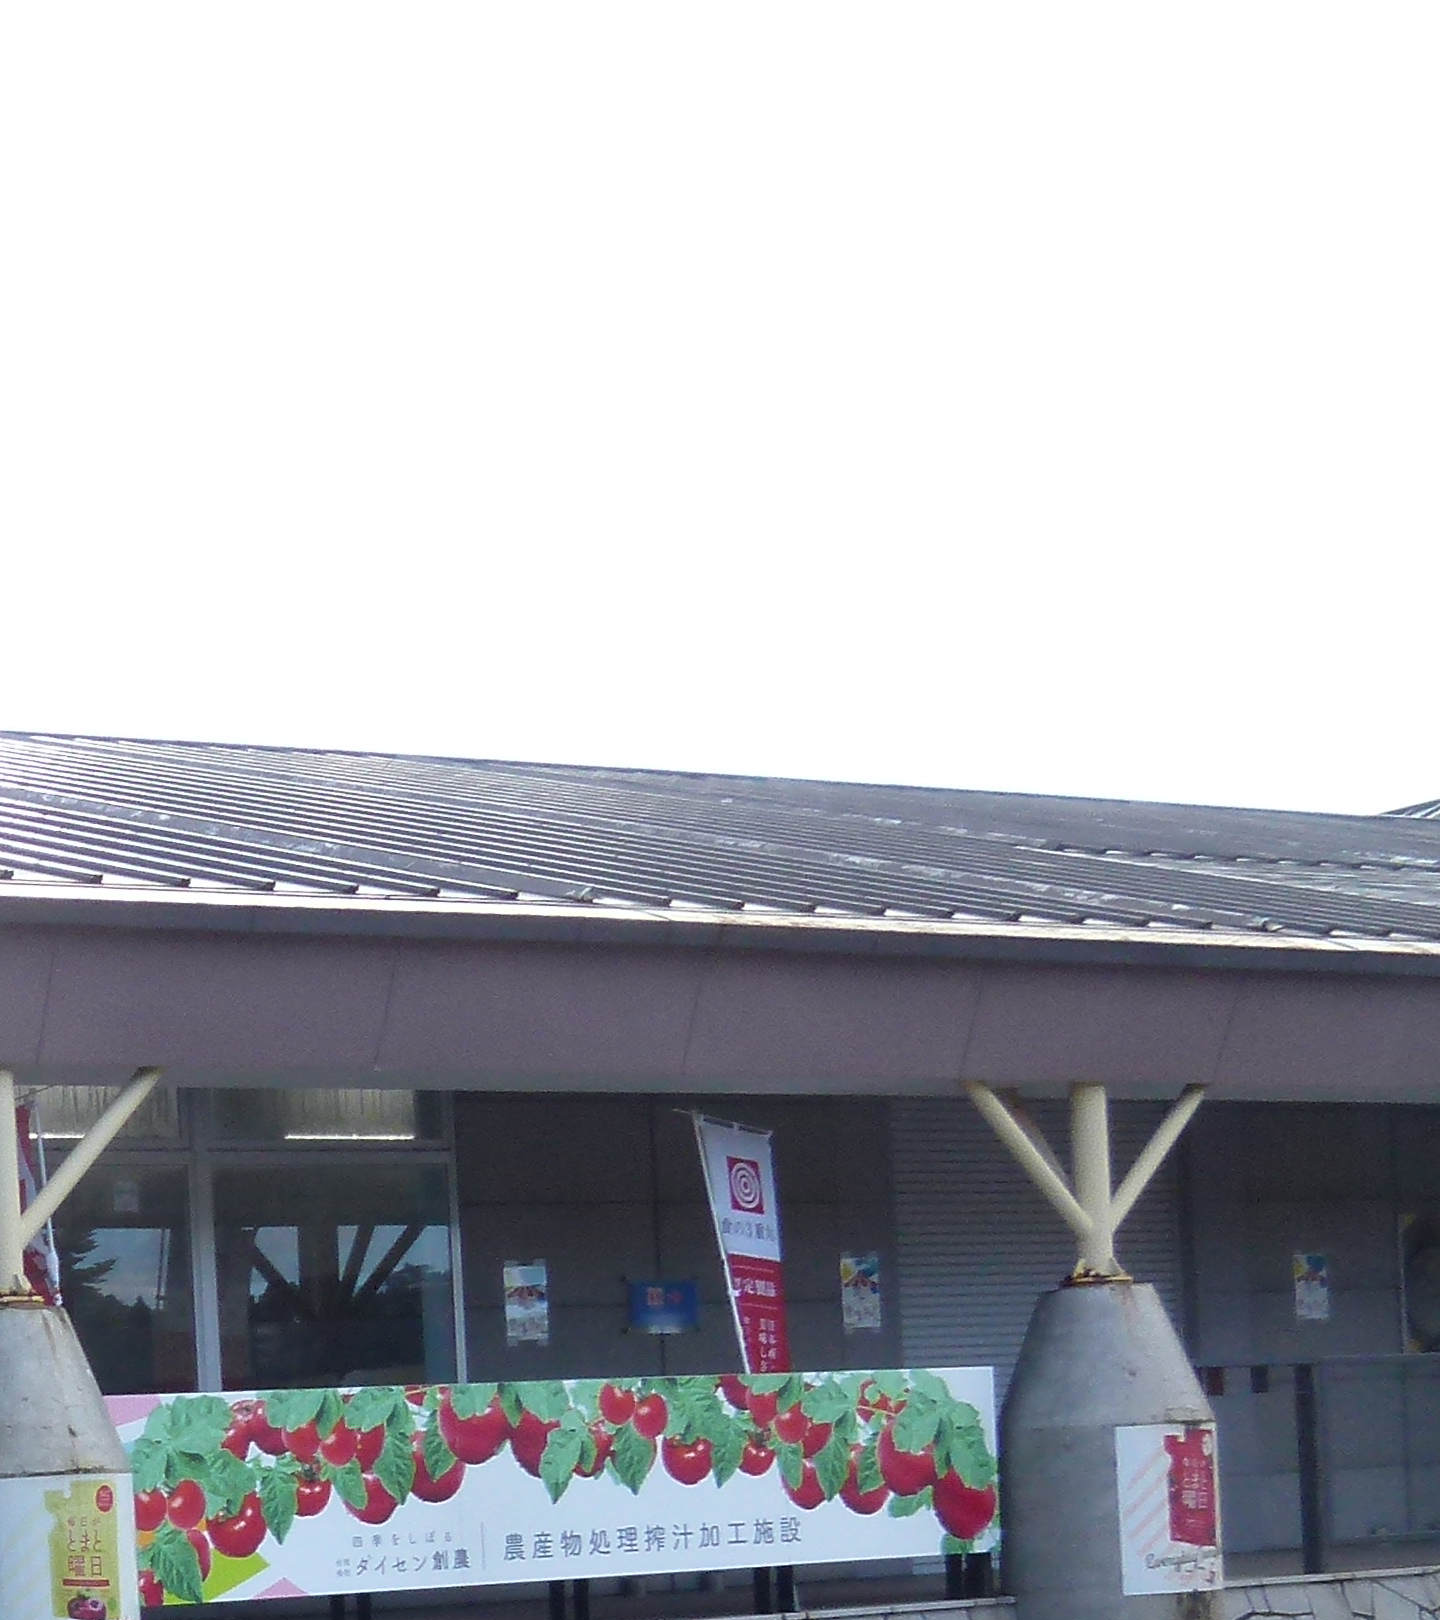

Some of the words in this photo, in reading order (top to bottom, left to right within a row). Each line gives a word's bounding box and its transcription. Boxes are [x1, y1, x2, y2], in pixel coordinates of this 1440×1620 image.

[67, 1529, 102, 1552] とまと
[503, 1516, 802, 1562] 農産物処理搾汁加工施設
